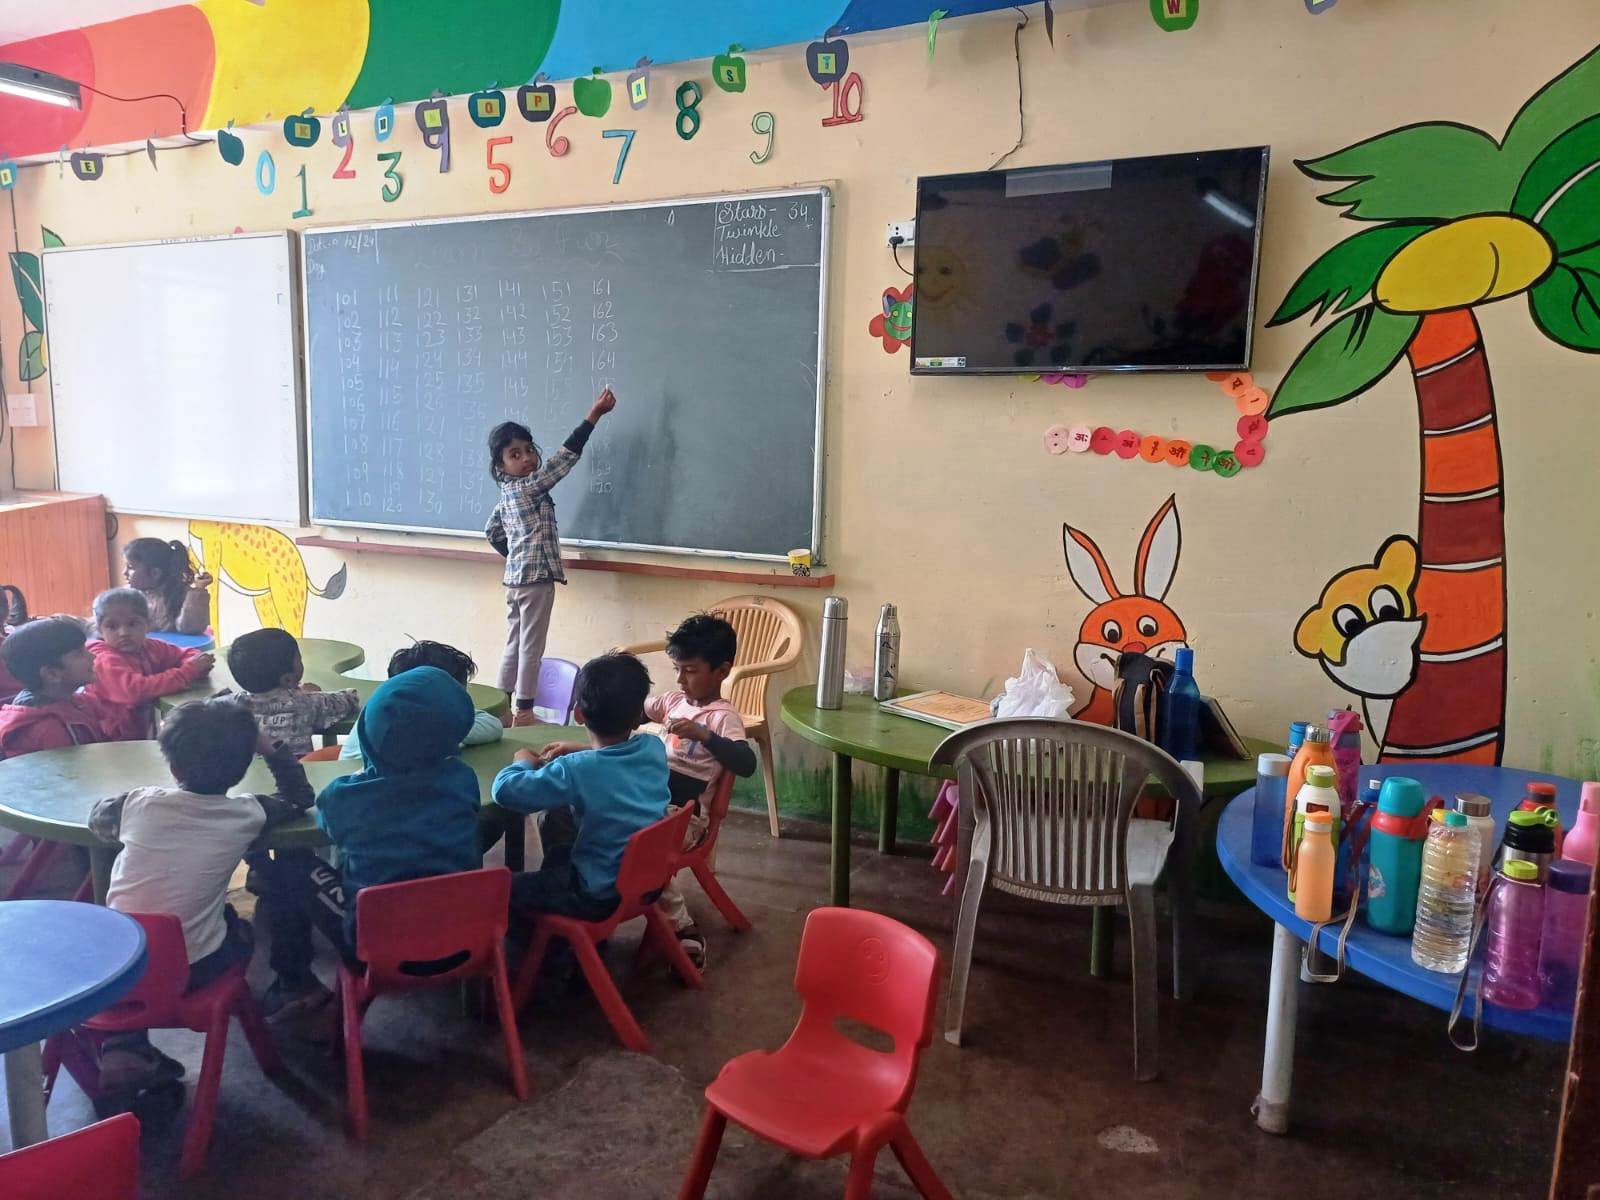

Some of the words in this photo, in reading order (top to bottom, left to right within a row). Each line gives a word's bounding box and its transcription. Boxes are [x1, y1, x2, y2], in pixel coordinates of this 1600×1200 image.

[255, 150, 276, 195] 0
[292, 163, 315, 219] 1
[332, 134, 356, 179] 2
[377, 151, 404, 202] 3
[487, 135, 513, 193] 5
[546, 106, 577, 157] 6
[602, 129, 637, 184] 7
[675, 80, 703, 141] 8
[749, 111, 774, 164] 9
[819, 72, 863, 127] 10
[715, 218, 783, 242] Twinkle
[336, 288, 357, 313] 101
[378, 284, 399, 304] 111
[416, 287, 440, 309] 121
[456, 283, 478, 304] 131
[498, 279, 521, 299] 141
[542, 280, 572, 302] 151
[592, 278, 611, 296] 161
[337, 310, 361, 334] 102
[379, 306, 403, 329] 112
[416, 310, 449, 334] 122
[457, 305, 481, 325] 132
[500, 303, 528, 324] 142
[545, 303, 573, 326] 152
[592, 300, 615, 319] 162
[416, 328, 447, 348] 123
[457, 325, 484, 345] 133
[502, 326, 526, 346] 143
[546, 325, 573, 347] 153
[591, 322, 618, 342] 163
[340, 354, 360, 374] 104
[416, 350, 443, 370] 124
[457, 346, 482, 367] 134
[591, 350, 616, 371] 164
[342, 373, 365, 392] 105
[415, 370, 446, 391] 125
[456, 371, 486, 393] 135
[504, 377, 529, 400] 145
[346, 461, 369, 484] 109
[382, 496, 403, 513] 120
[418, 487, 443, 515] 130
[272, 715, 286, 725] UP
